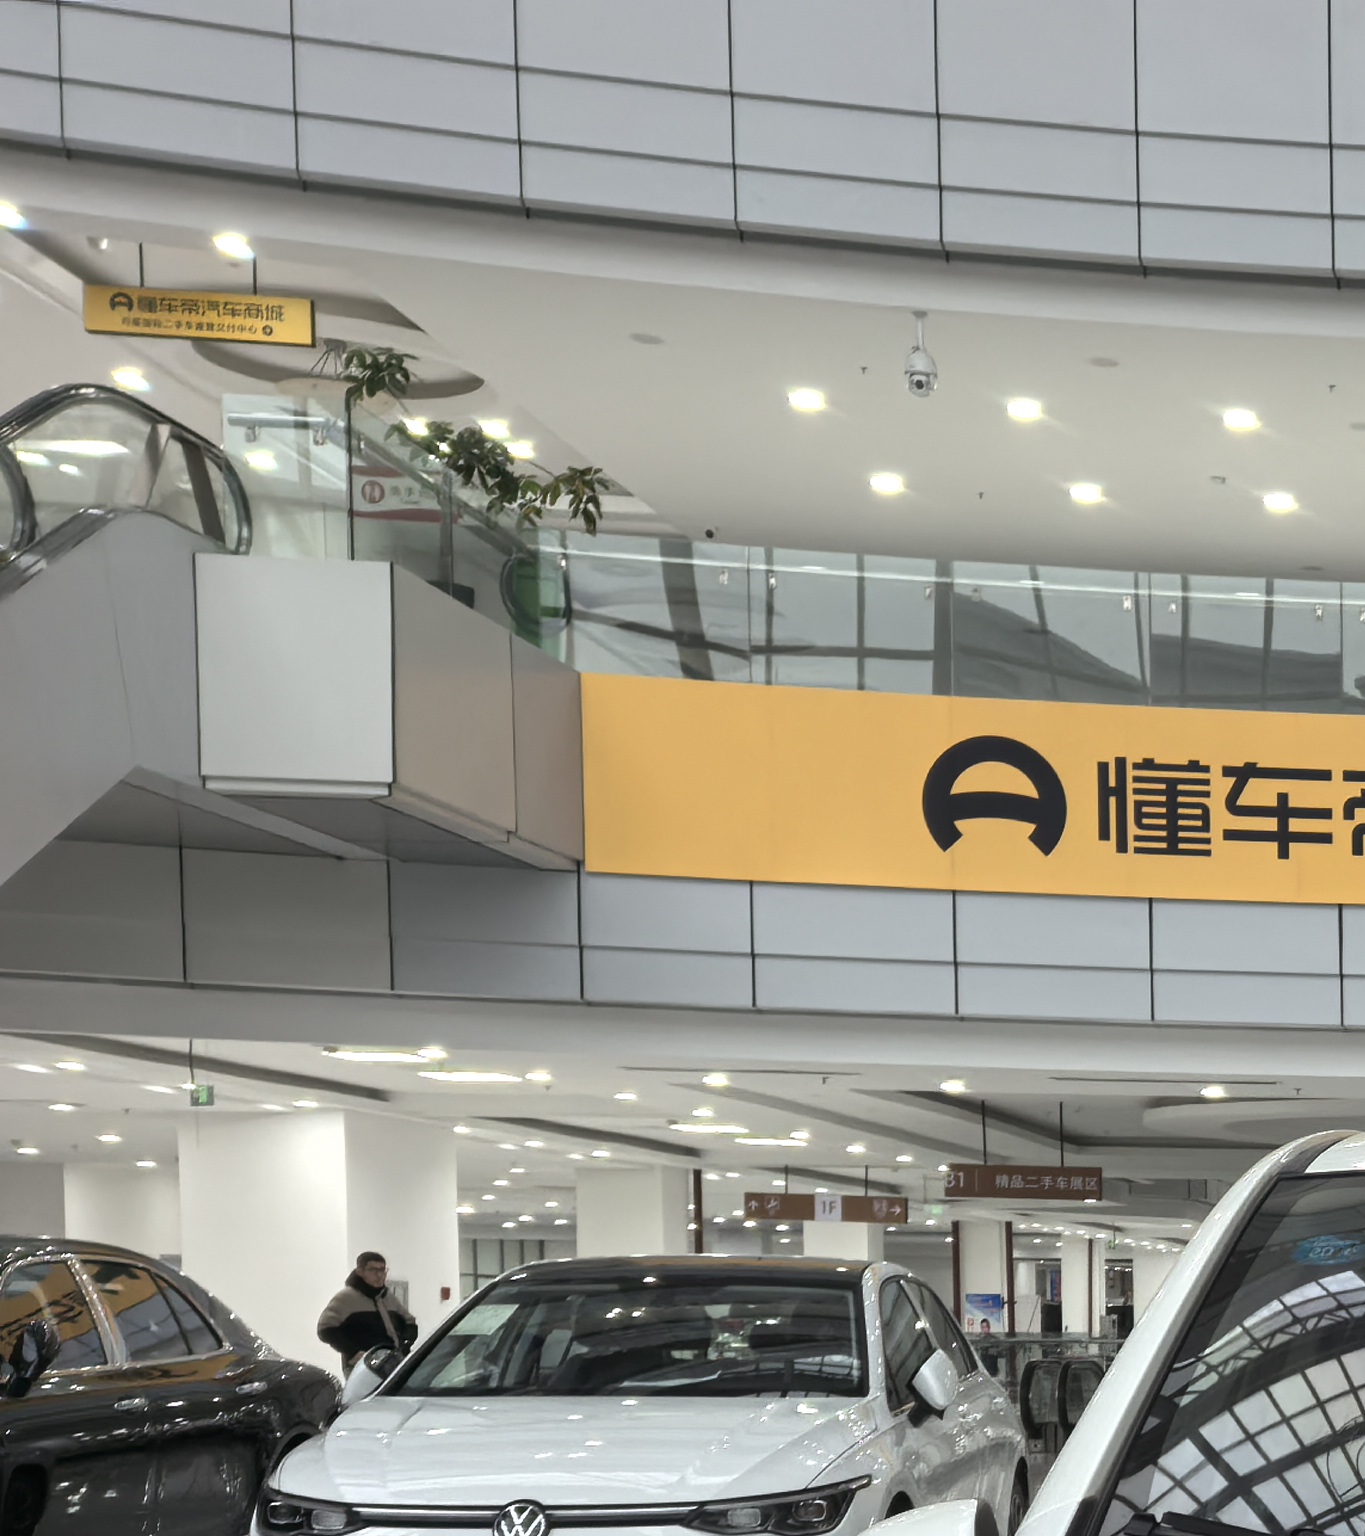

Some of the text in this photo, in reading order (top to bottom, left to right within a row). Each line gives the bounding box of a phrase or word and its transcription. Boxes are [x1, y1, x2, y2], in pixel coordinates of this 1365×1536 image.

[995, 1173, 1098, 1191] 精品二手车展区
